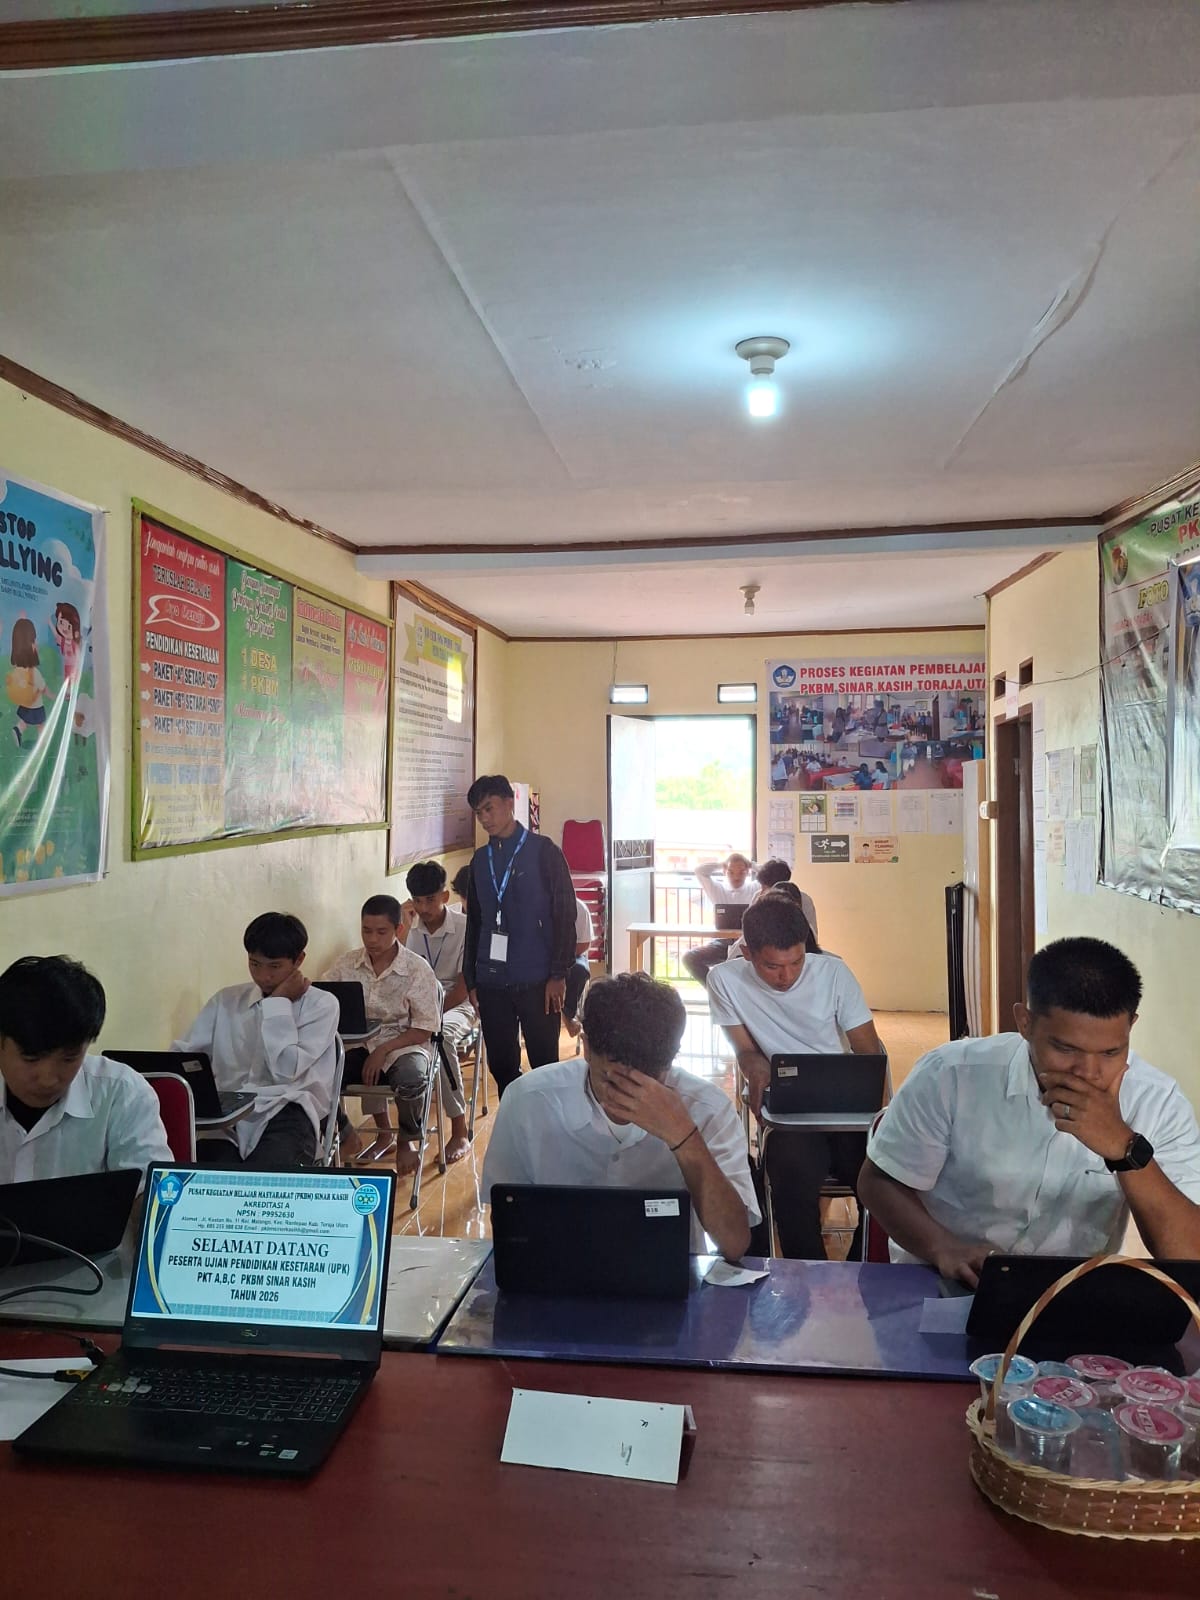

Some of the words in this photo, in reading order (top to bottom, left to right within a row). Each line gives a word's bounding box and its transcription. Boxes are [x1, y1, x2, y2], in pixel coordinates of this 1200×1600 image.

[1150, 510, 1181, 534] PUSAT
[145, 630, 183, 656] PENDIDIKAN
[184, 641, 219, 665] KESETARAAN
[251, 648, 277, 672] DESA
[154, 660, 174, 682] PAKET
[184, 666, 206, 688] SETARA
[800, 667, 845, 679] PROSES
[850, 665, 905, 676] KEGIATAN
[800, 683, 834, 694] PKBM
[838, 682, 873, 694] SINAR
[877, 680, 913, 692] KASIH
[917, 679, 962, 691] TORAJA
[154, 687, 174, 708] PAKET
[185, 692, 206, 712] SETARA
[154, 714, 174, 734] PAKET
[205, 1188, 233, 1197] KEGIATAN
[234, 1190, 257, 1198] BELAJAR
[258, 1191, 294, 1199] MASYARAKAT
[295, 1192, 314, 1201] (PKBM)
[314, 1193, 331, 1201] SINAR
[236, 1209, 256, 1217] NPSN
[243, 1201, 283, 1209] AKREDITASI
[191, 1237, 263, 1255] SELAMAT
[266, 1241, 329, 1258] DATANG
[168, 1255, 202, 1267] PESERTA
[204, 1257, 228, 1268] UJIAN
[230, 1258, 278, 1271] PENDIDIKAN
[279, 1260, 325, 1273] KESETARAN
[327, 1262, 350, 1275] (UPK)
[197, 1272, 213, 1283] PKT
[214, 1273, 236, 1285] A,B,C
[240, 1274, 264, 1285] PKBM
[266, 1275, 290, 1287] SINAR
[292, 1276, 316, 1288] KASIH
[230, 1288, 257, 1301] TAHUN
[258, 1290, 279, 1302] 2026
